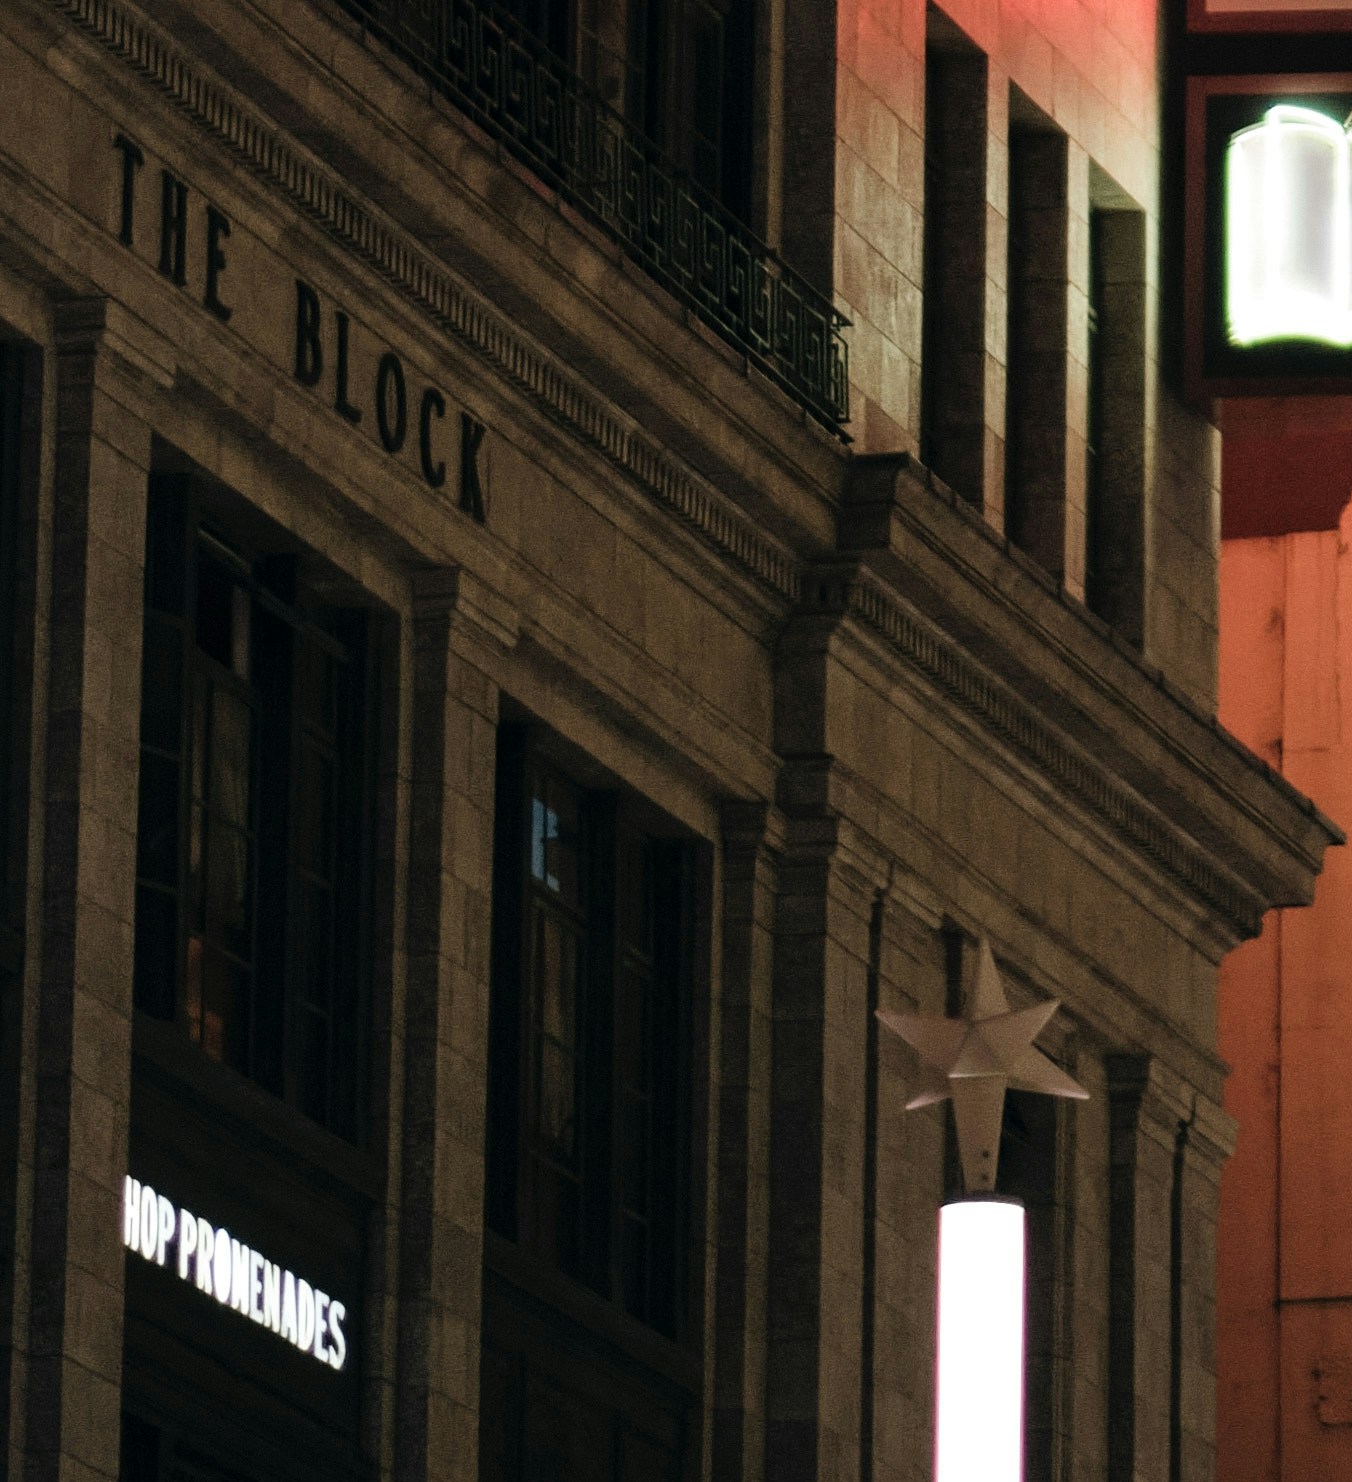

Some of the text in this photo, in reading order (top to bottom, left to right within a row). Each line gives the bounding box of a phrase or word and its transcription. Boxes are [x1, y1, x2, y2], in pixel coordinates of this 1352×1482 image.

[114, 132, 490, 524] THE BLOCK
[177, 1207, 347, 1371] PROMENADES
